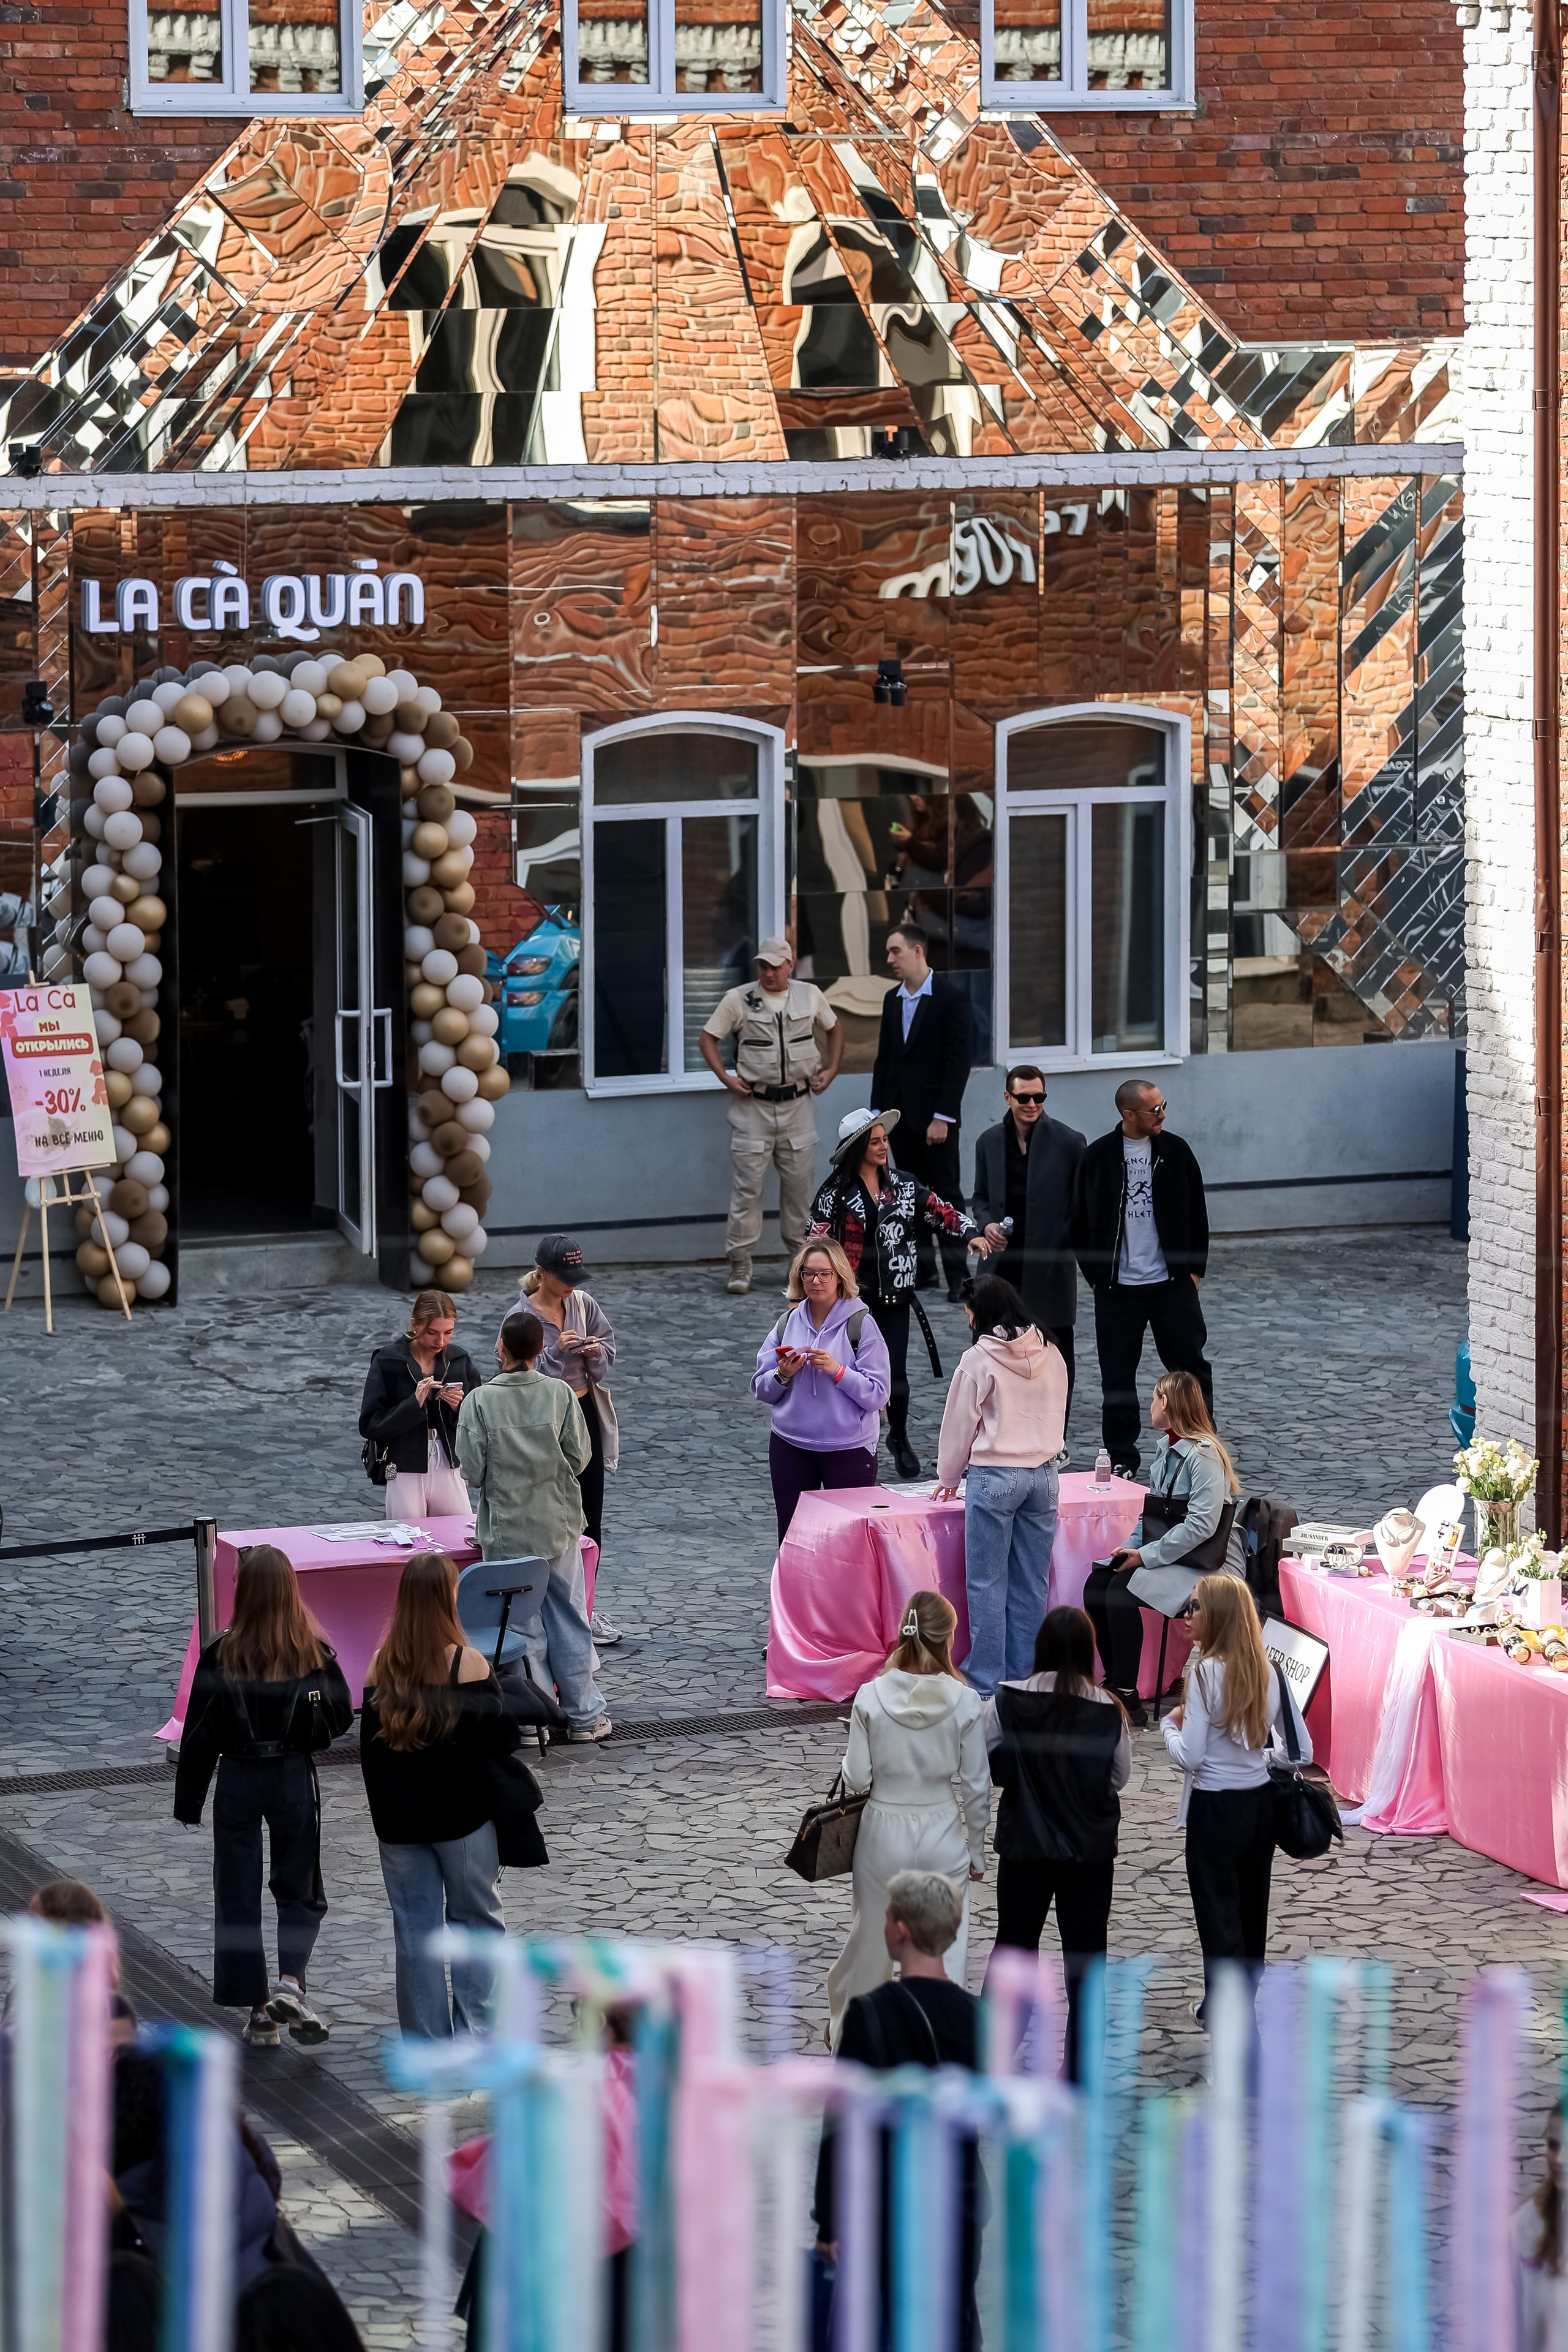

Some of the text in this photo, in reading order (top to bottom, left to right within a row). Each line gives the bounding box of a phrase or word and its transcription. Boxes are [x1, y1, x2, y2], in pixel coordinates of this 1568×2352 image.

[82, 578, 159, 633] LA
[173, 560, 250, 631] CÀ
[14, 985, 76, 1012] La Cà
[15, 1038, 89, 1054] ОТКРЫЛИСЬ
[43, 1066, 71, 1077] НЕДЕЛЯ
[35, 1087, 86, 1115] -30%
[35, 1136, 48, 1147] НА
[74, 1129, 104, 1144] МЕНЮ
[1283, 1656, 1310, 1683] SHOP
